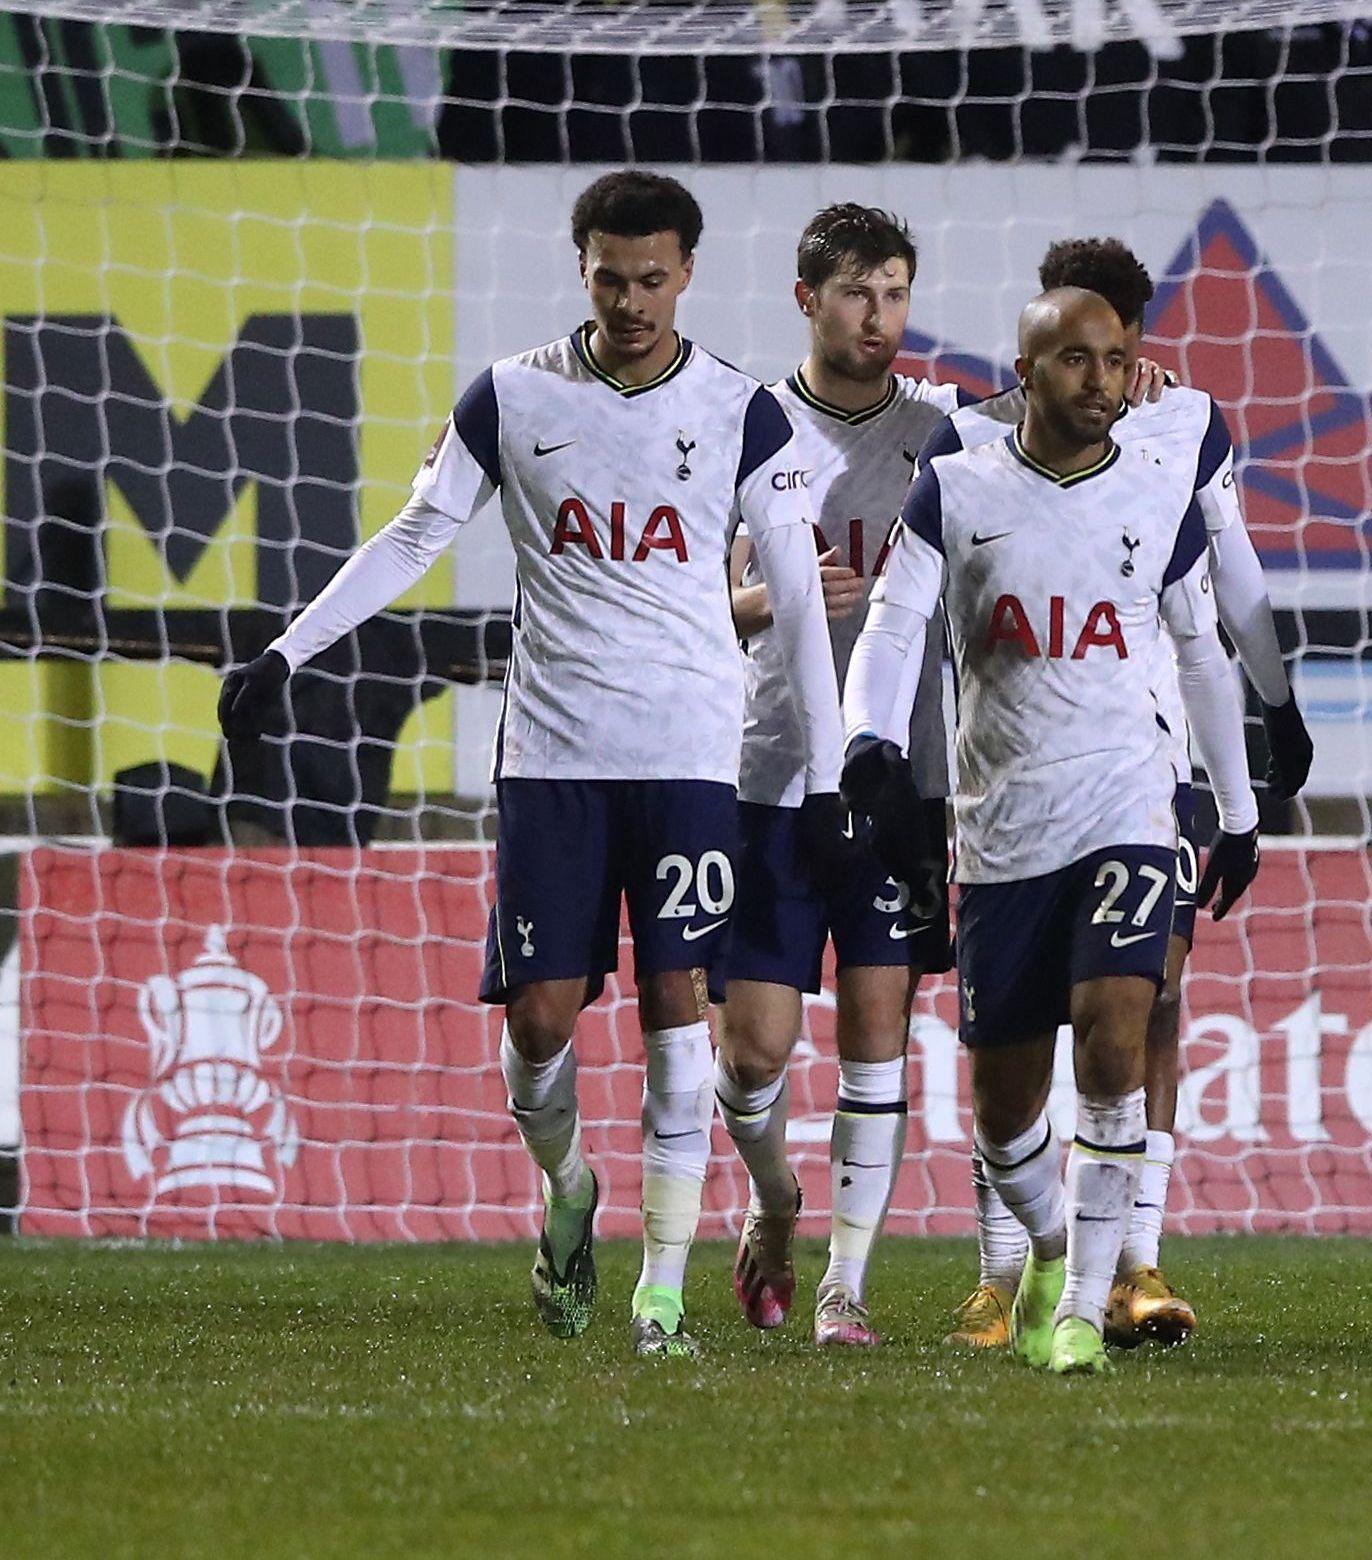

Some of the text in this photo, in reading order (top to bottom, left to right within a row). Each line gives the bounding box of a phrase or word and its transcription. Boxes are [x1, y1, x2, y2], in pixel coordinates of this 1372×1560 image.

[551, 497, 689, 563] AIA
[983, 594, 1128, 660] AIA
[656, 849, 735, 918] 20
[1091, 860, 1169, 927] 27
